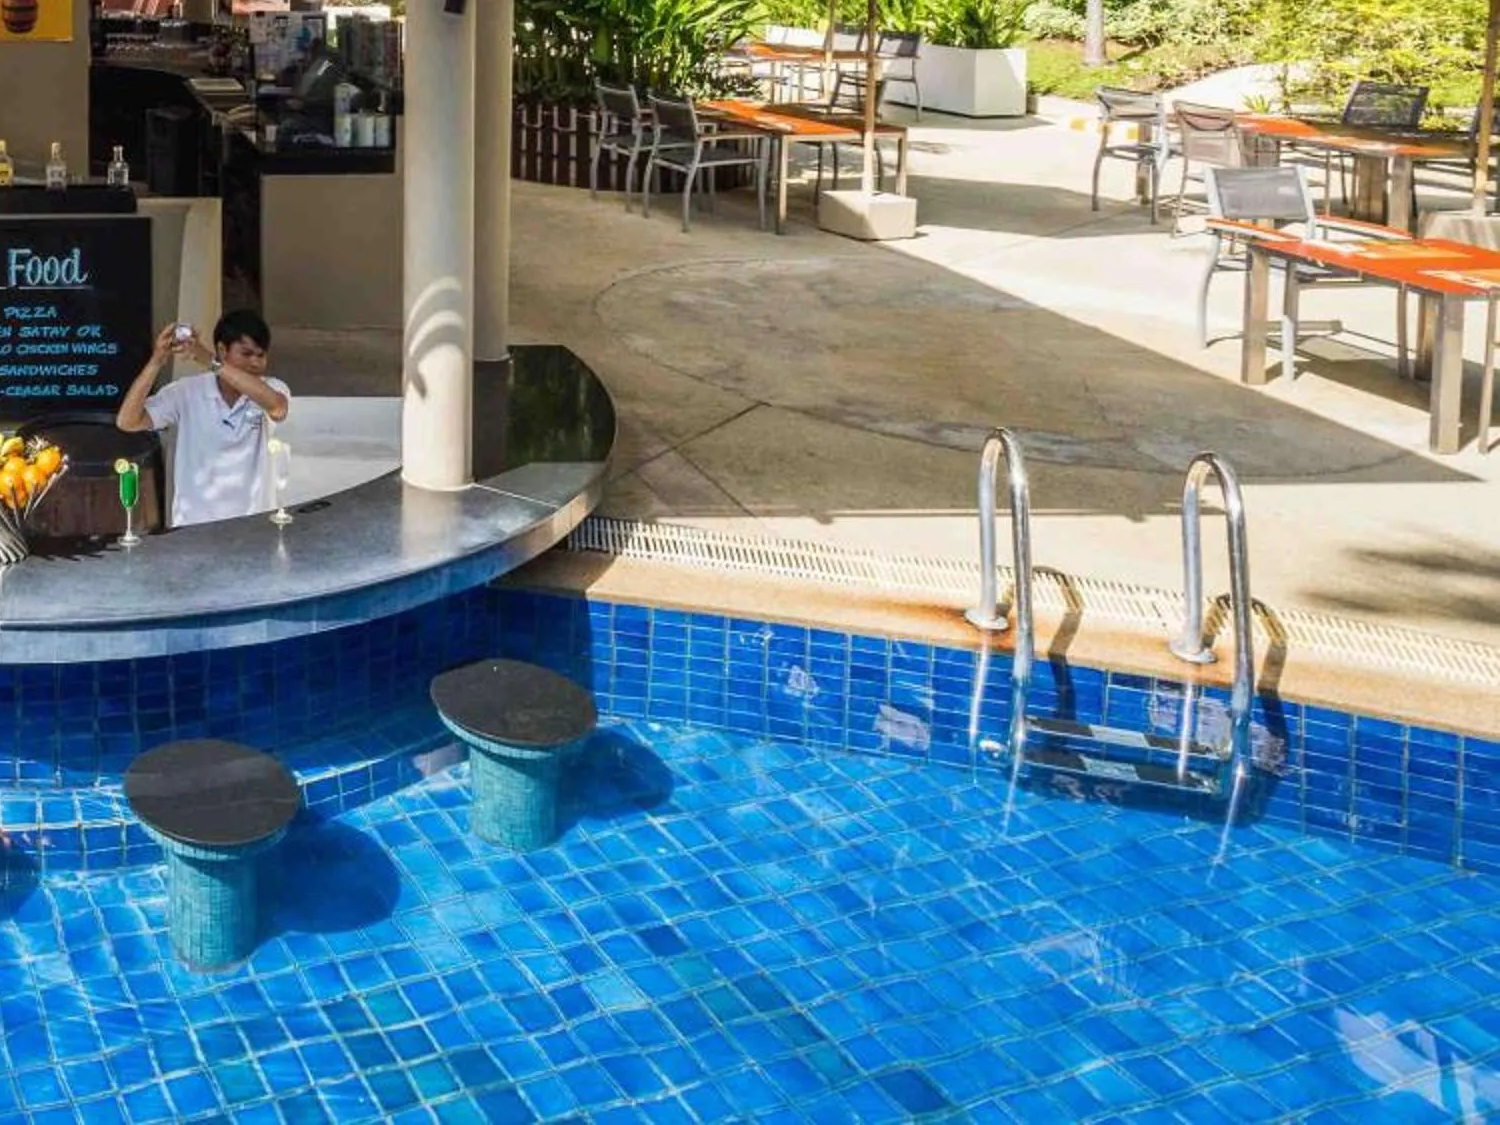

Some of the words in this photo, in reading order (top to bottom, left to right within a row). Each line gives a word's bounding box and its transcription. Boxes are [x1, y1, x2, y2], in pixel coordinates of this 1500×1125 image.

[7, 247, 89, 288] Food
[3, 306, 58, 319] PIZZA
[17, 325, 70, 338] SATAY
[16, 343, 69, 355] CHICKEN
[71, 342, 119, 355] WINGS
[65, 384, 120, 396] SALAD
